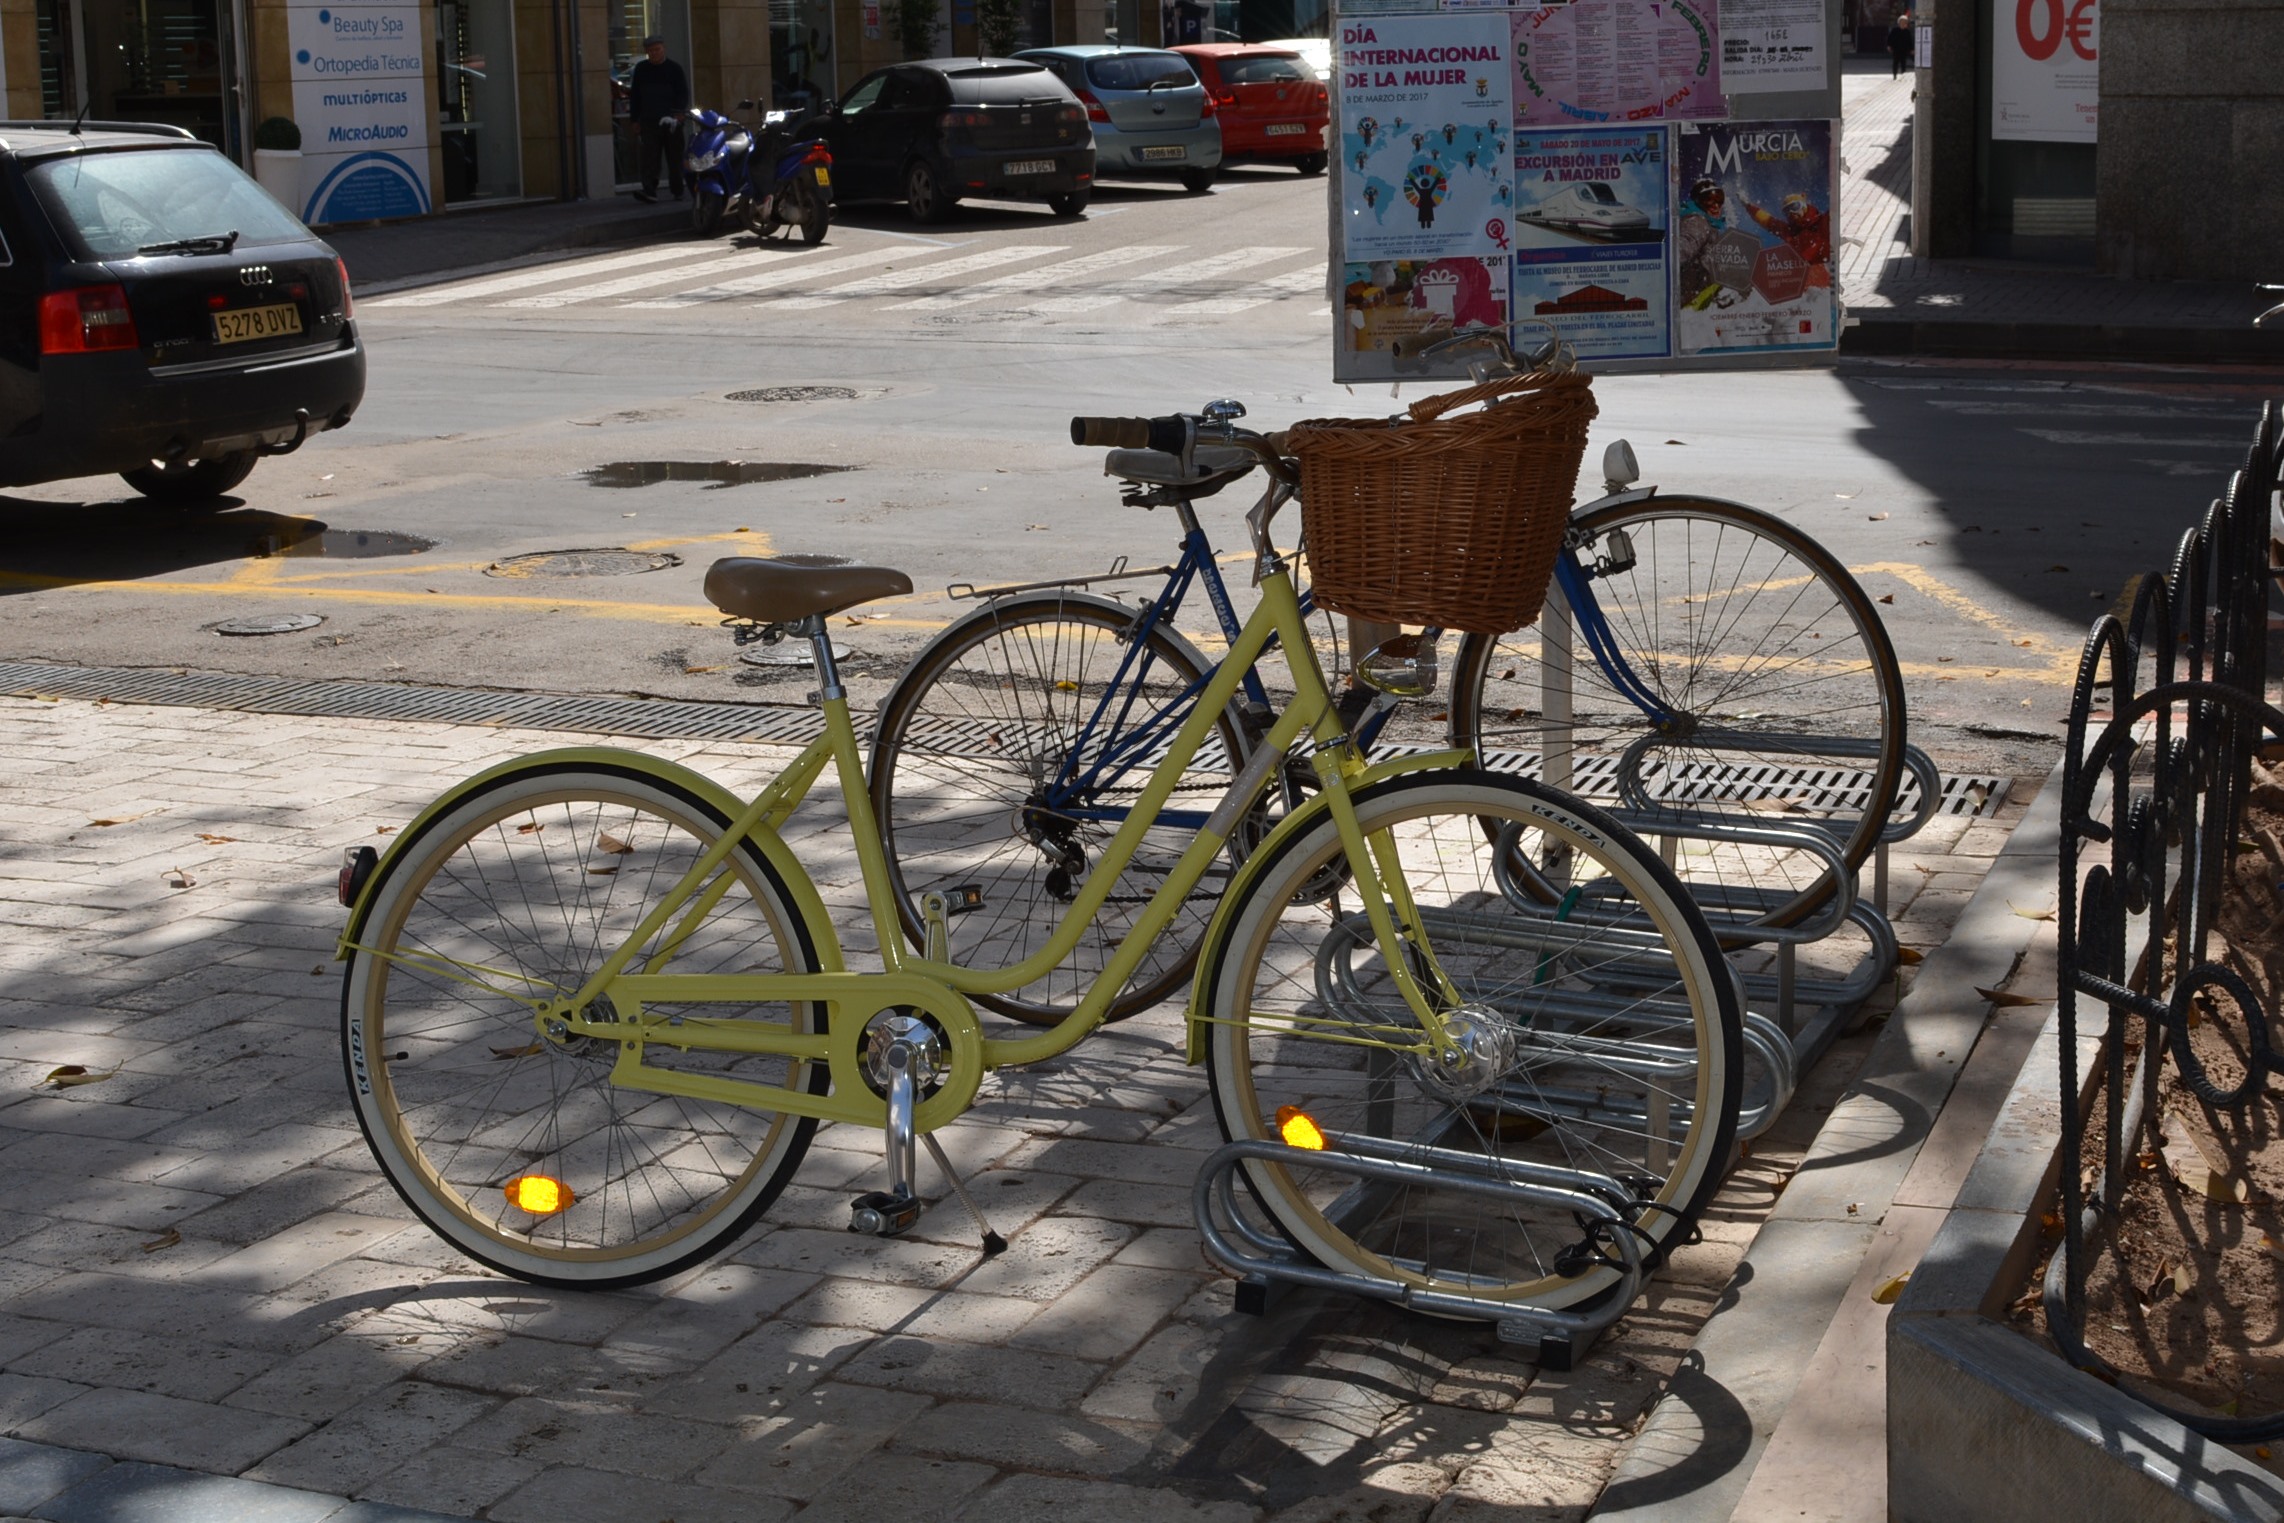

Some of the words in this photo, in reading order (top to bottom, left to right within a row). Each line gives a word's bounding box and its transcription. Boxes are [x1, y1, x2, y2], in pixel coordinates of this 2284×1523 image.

[334, 17, 378, 36] Beauty
[381, 16, 404, 35] Spa
[1186, 20, 1197, 33] P
[1343, 23, 1378, 44] DÍA
[1671, 1, 1711, 77] FEBRERO
[314, 55, 379, 75] Ortopedia
[381, 54, 420, 71] Técnica
[1344, 46, 1501, 66] INTERNACIONAL
[1345, 73, 1369, 88] DE
[1375, 71, 1399, 88] LA
[1404, 69, 1467, 86] MUJER
[1517, 42, 1544, 97] MAYO
[1346, 96, 1352, 104] 8
[1353, 95, 1364, 103] DE
[1365, 94, 1395, 103] MARZO
[1396, 93, 1407, 102] DE
[1409, 92, 1429, 102] 2017
[1558, 100, 1610, 121] ABRIL
[1540, 139, 1568, 149] SÁBADO
[1570, 140, 1579, 148] 20
[1580, 140, 1590, 148] DE
[1592, 139, 1611, 147] MAYO
[1613, 138, 1622, 146] DE
[1623, 138, 1640, 146] 2017
[1514, 153, 1596, 169] EXCURSIÓN
[1599, 154, 1619, 167] EN
[1620, 148, 1661, 165] AVE
[1704, 133, 1803, 174] MURCIA
[1756, 150, 1780, 161] BAJO
[1009, 162, 1034, 174] 7718
[1035, 160, 1053, 171] GCY
[1543, 169, 1555, 182] A
[1559, 167, 1621, 181] MADRID
[1705, 255, 1748, 264] NEVADA
[1706, 245, 1741, 255] SIERRA
[1766, 253, 1778, 262] LA
[219, 312, 265, 340] 5278
[267, 308, 299, 333] DVZ
[1533, 805, 1604, 848] KENDA
[352, 1020, 369, 1094] KENDA
